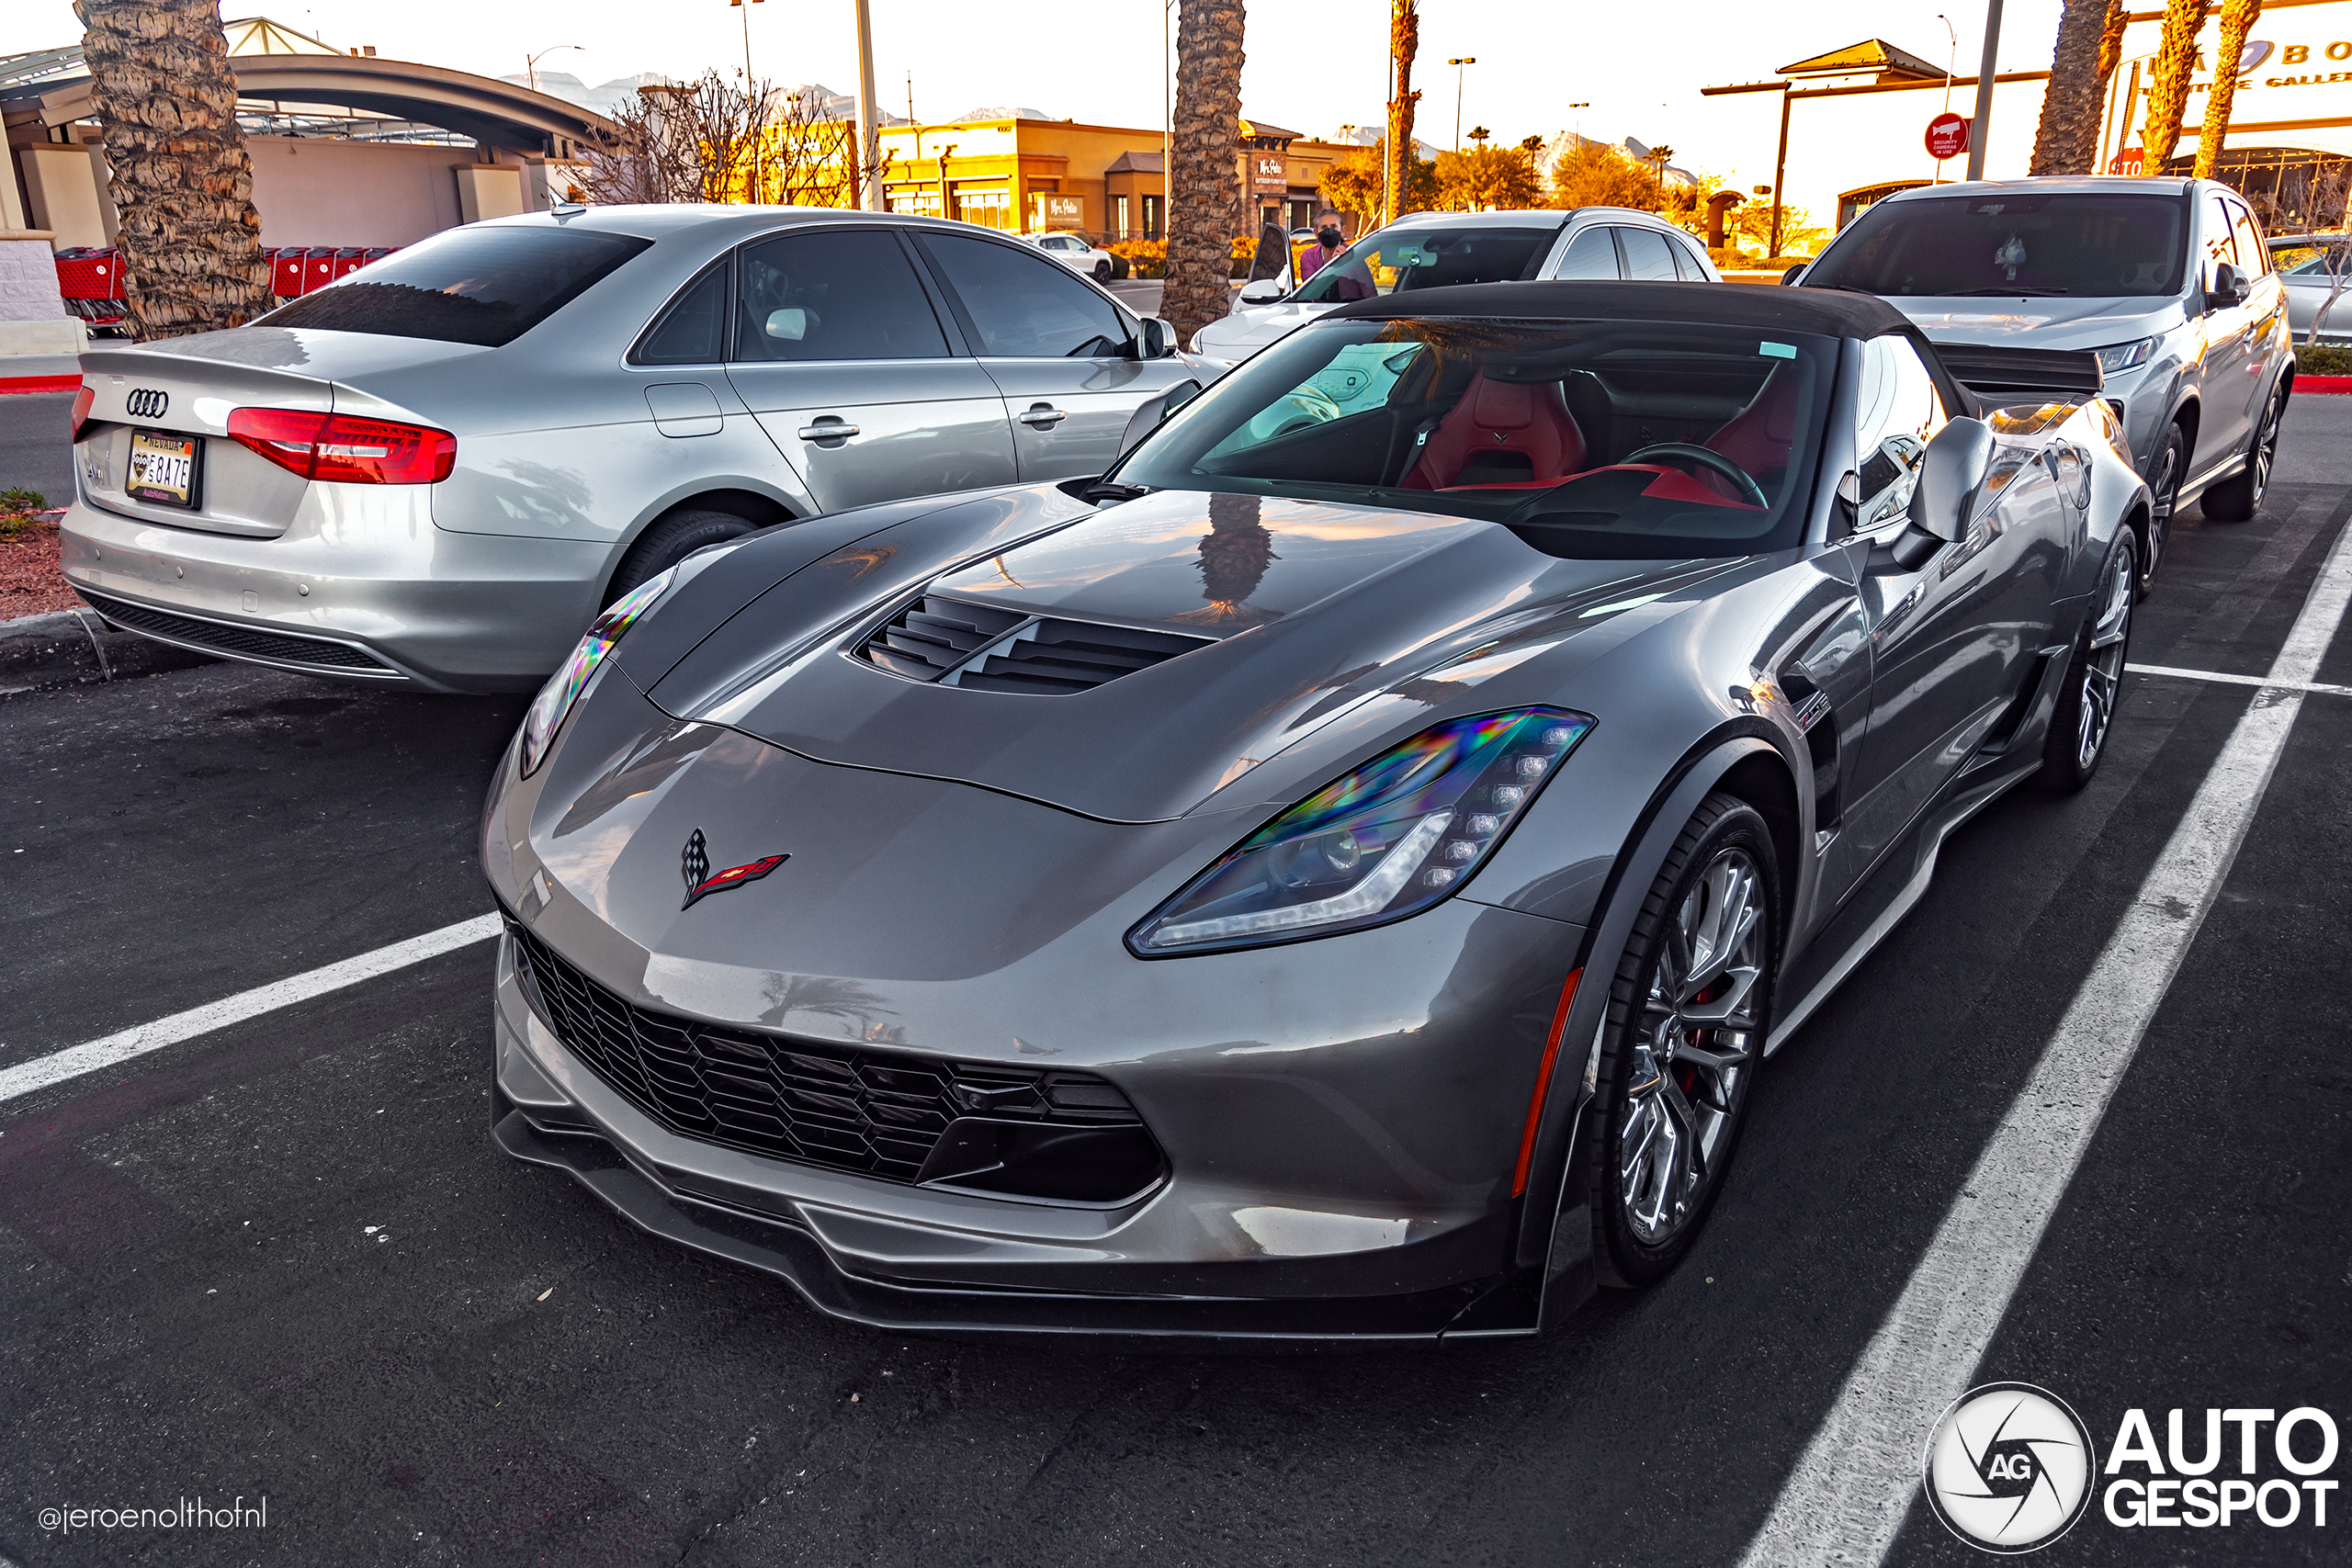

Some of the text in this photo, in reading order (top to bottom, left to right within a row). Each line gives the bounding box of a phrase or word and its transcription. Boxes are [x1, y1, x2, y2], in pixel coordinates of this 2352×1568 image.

[2110, 160, 2143, 175] TO
[149, 437, 179, 451] NEVADA
[142, 488, 170, 501] AutoNation
